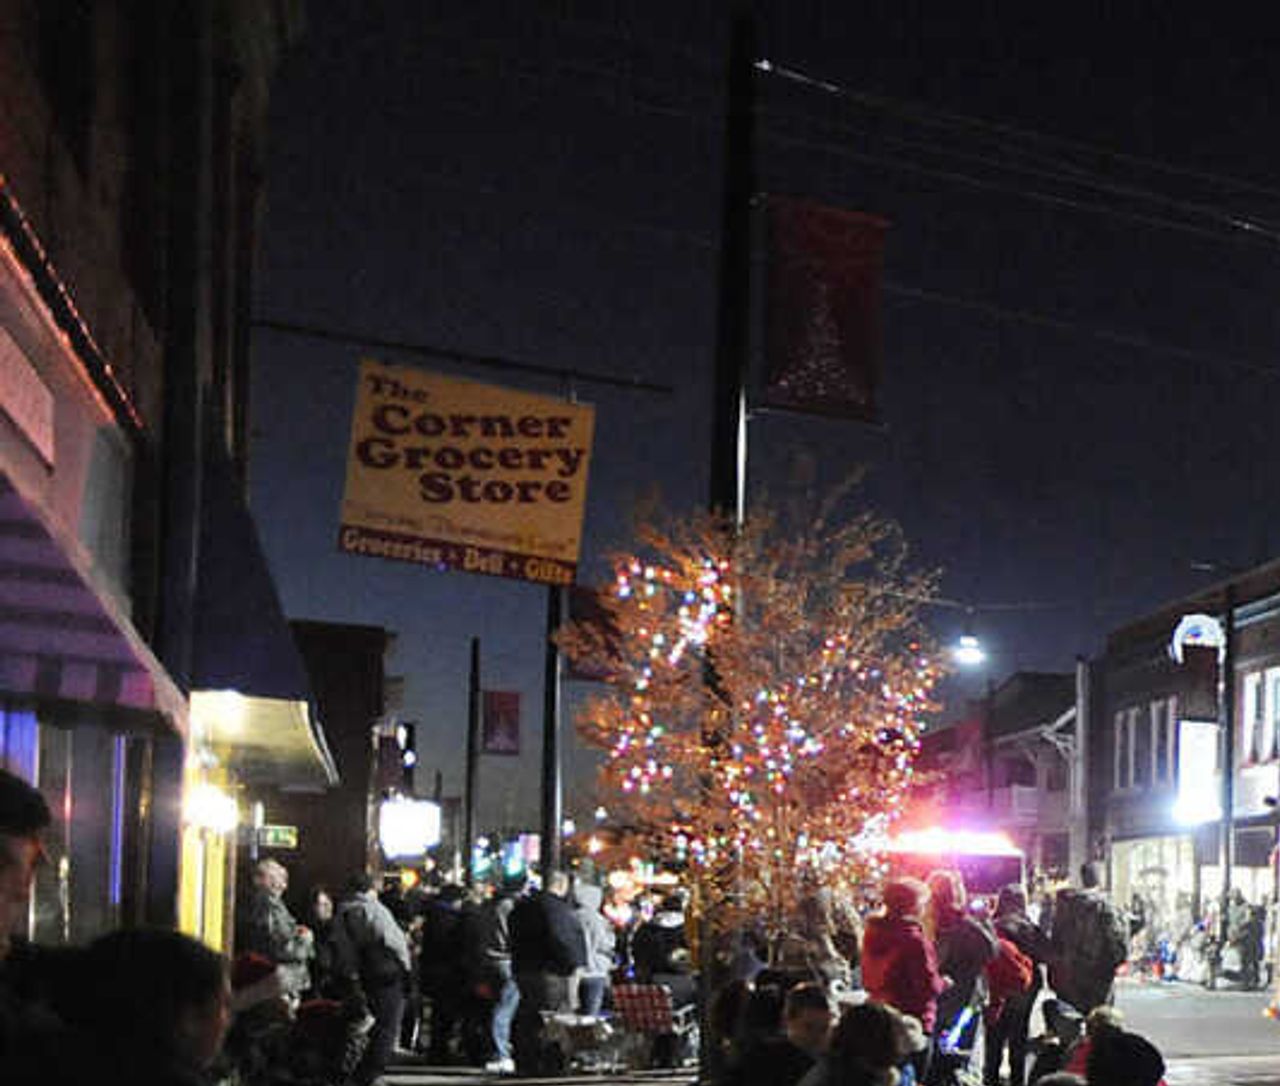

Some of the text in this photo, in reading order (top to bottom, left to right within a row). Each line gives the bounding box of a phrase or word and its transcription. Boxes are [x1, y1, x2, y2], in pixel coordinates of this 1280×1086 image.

[366, 373, 429, 401] The
[371, 403, 573, 438] Corner
[356, 438, 586, 478] Grocery
[418, 471, 573, 503] Store
